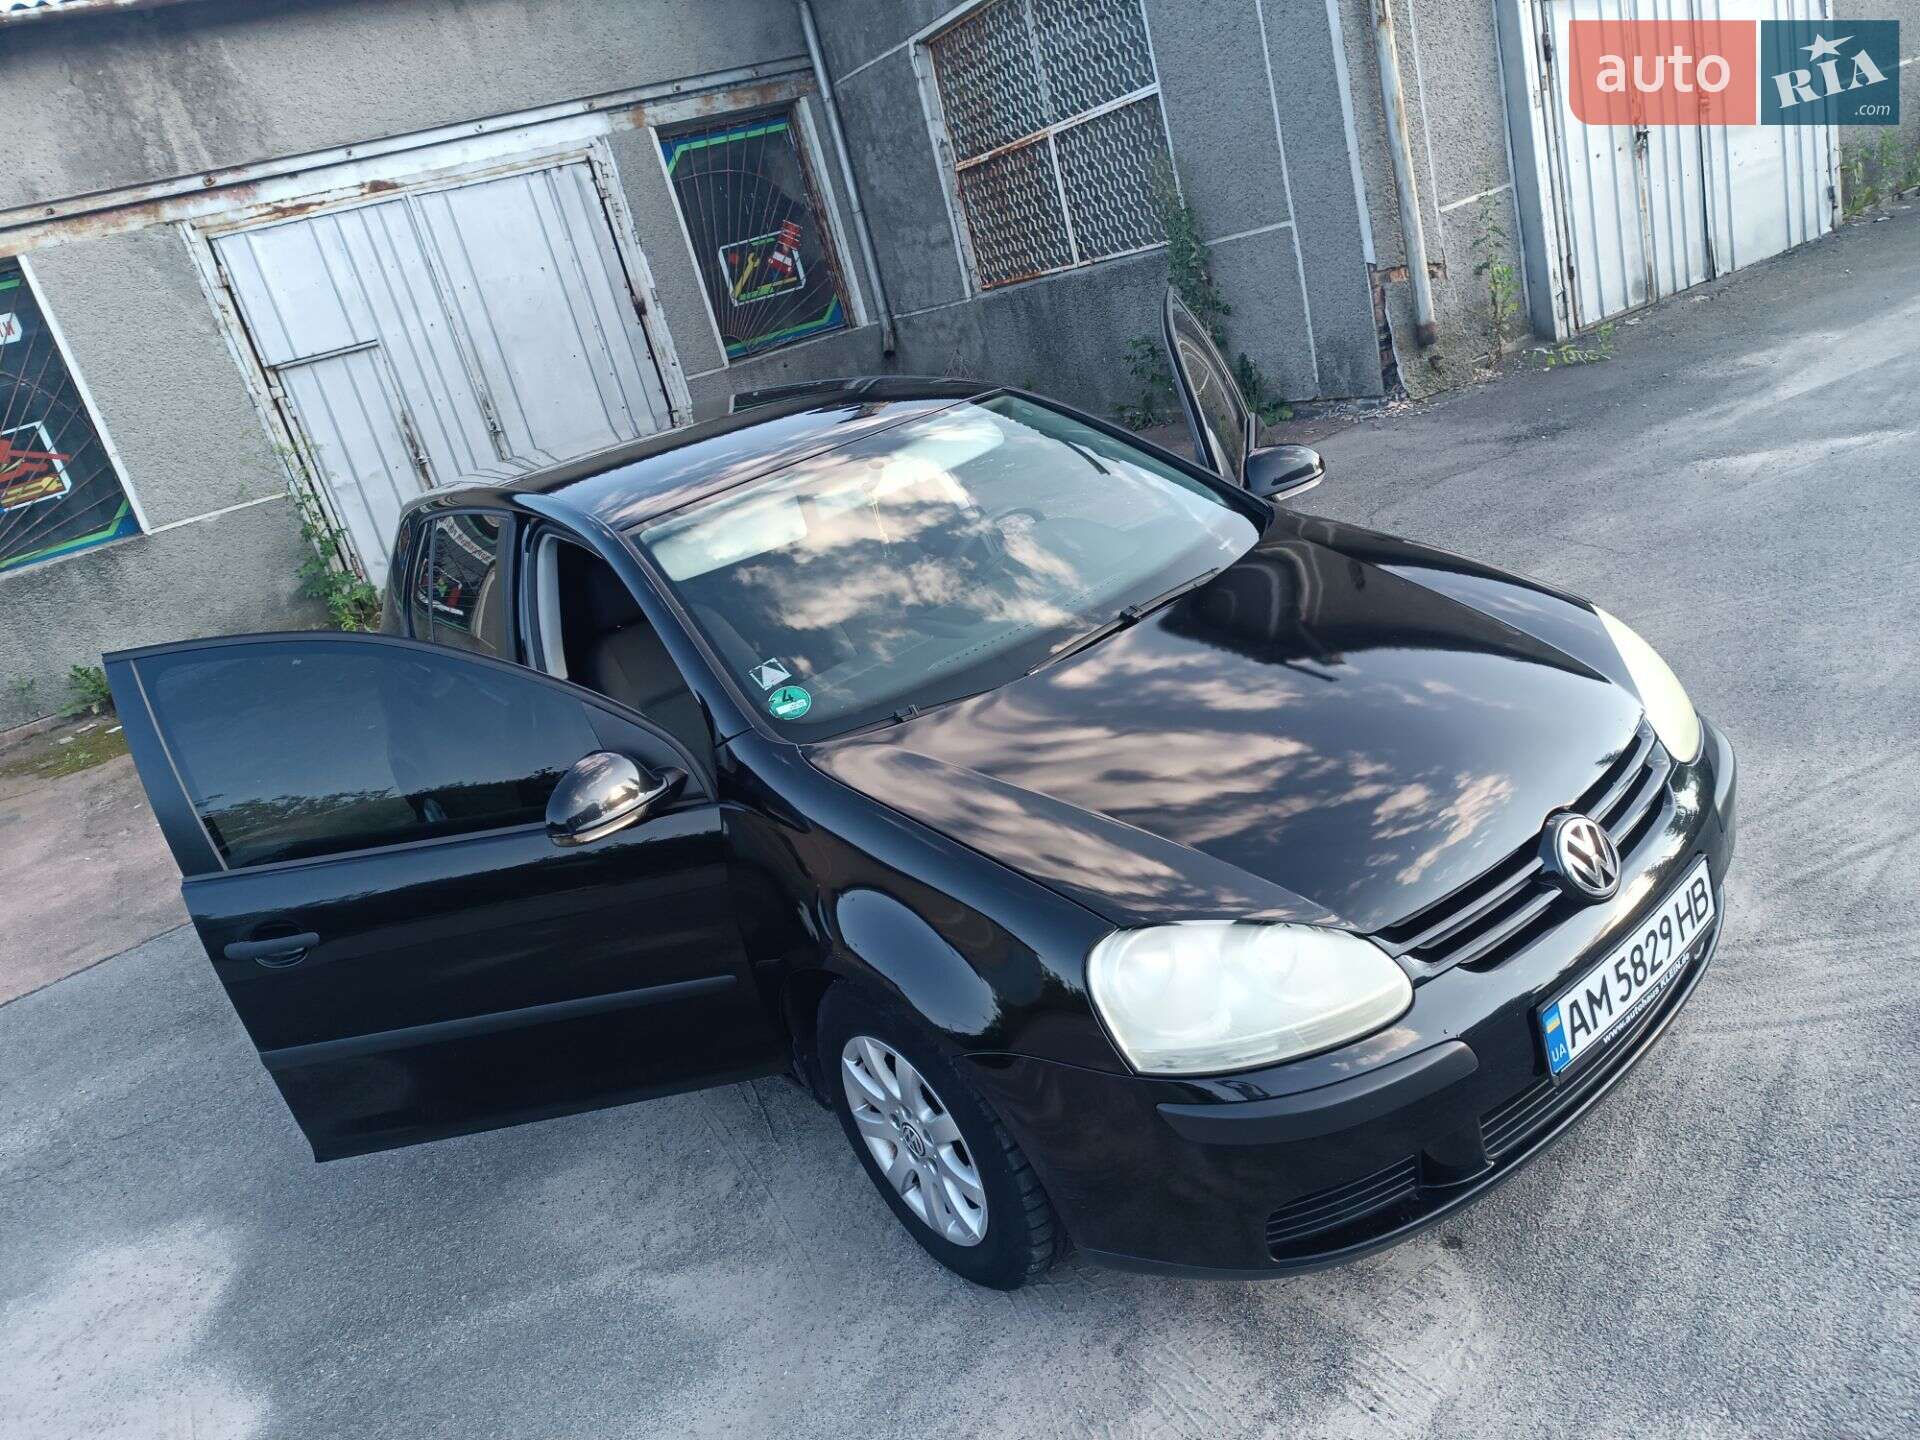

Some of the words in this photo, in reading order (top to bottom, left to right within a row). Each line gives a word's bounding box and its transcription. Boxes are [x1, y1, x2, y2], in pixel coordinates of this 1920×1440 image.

[782, 689, 794, 702] 4
[1560, 818, 1618, 893] VW
[1568, 974, 1614, 1049] AM
[1614, 915, 1673, 1003] 5829
[1675, 877, 1709, 943] HB
[1551, 1043, 1567, 1062] UA
